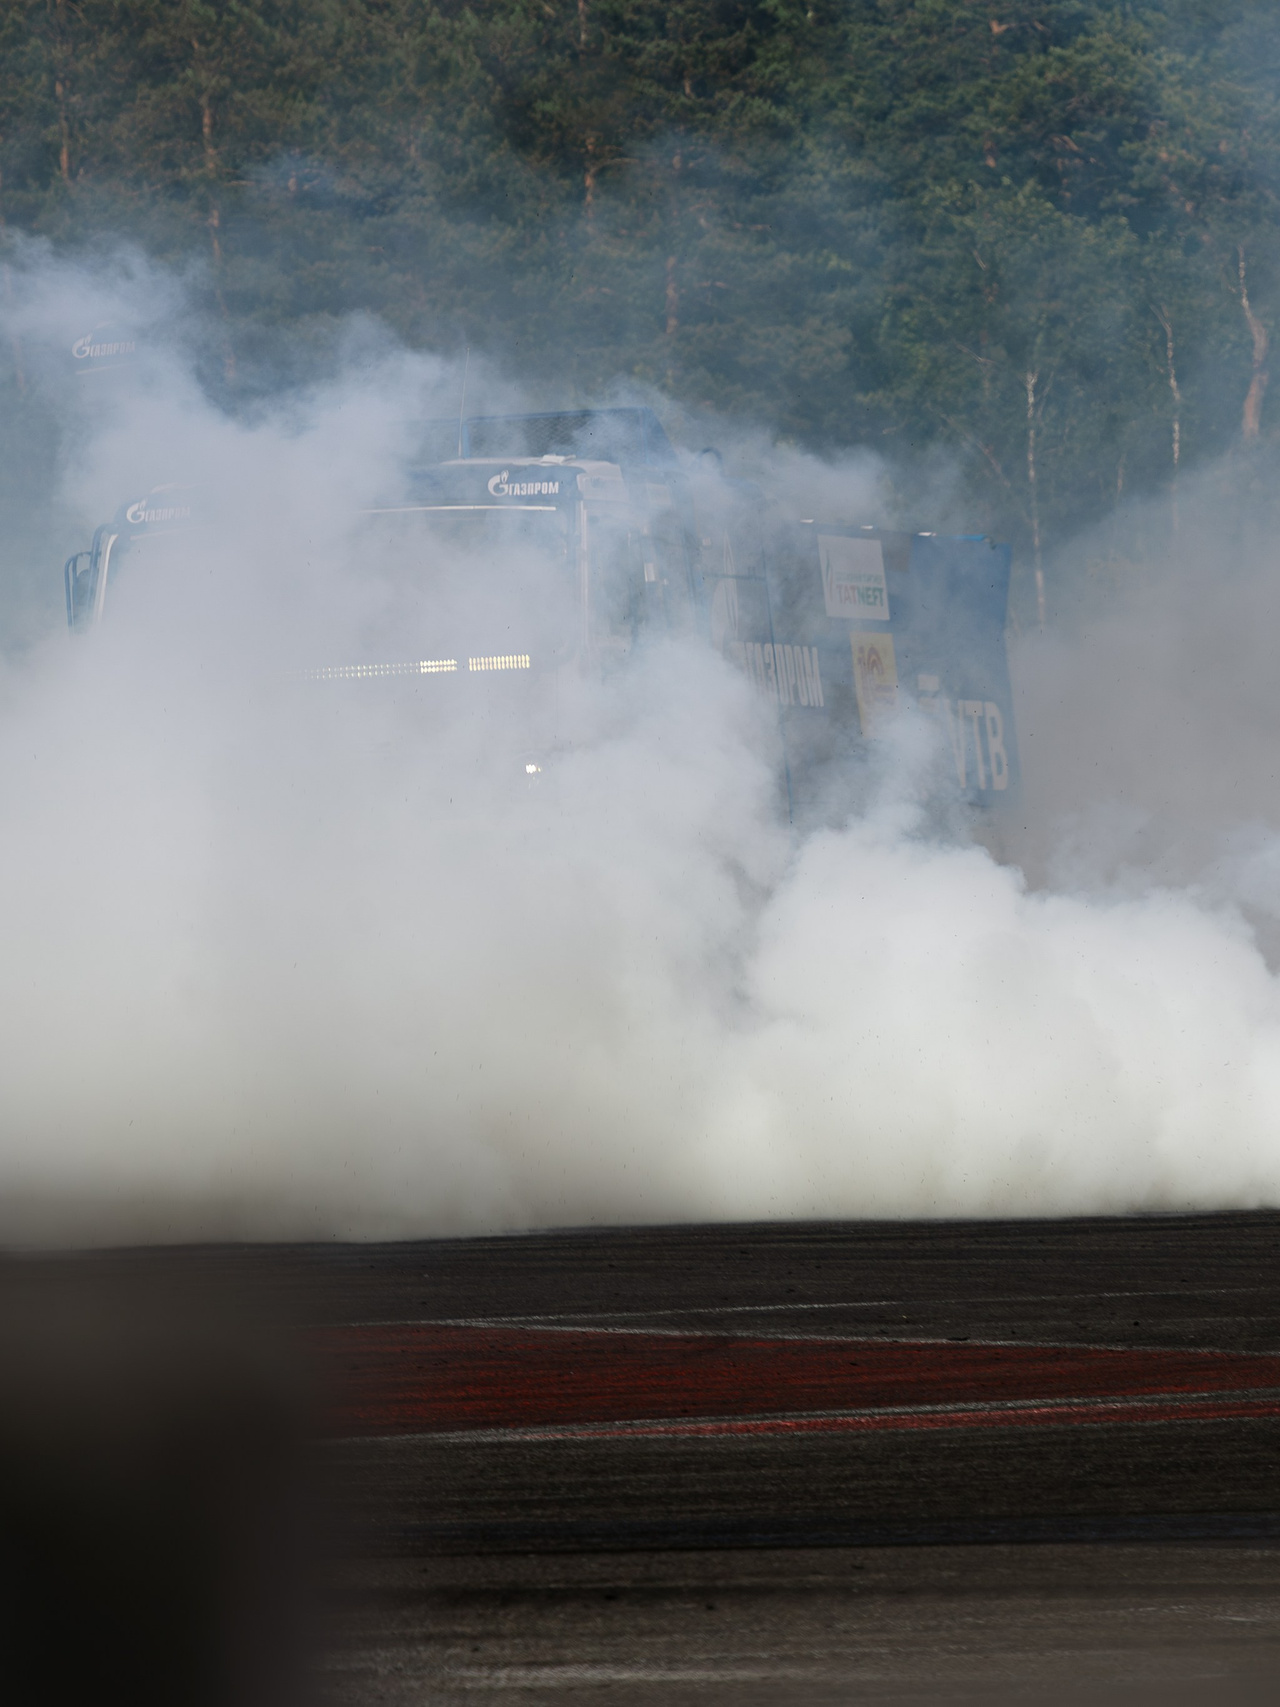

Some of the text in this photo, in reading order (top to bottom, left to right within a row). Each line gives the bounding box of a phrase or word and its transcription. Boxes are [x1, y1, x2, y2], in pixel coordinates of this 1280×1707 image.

[89, 341, 136, 358] ГАЗПРОМ
[508, 481, 560, 496] ГАЗПРОМ
[836, 583, 884, 607] TATNEFT
[942, 697, 1009, 791] VTB
